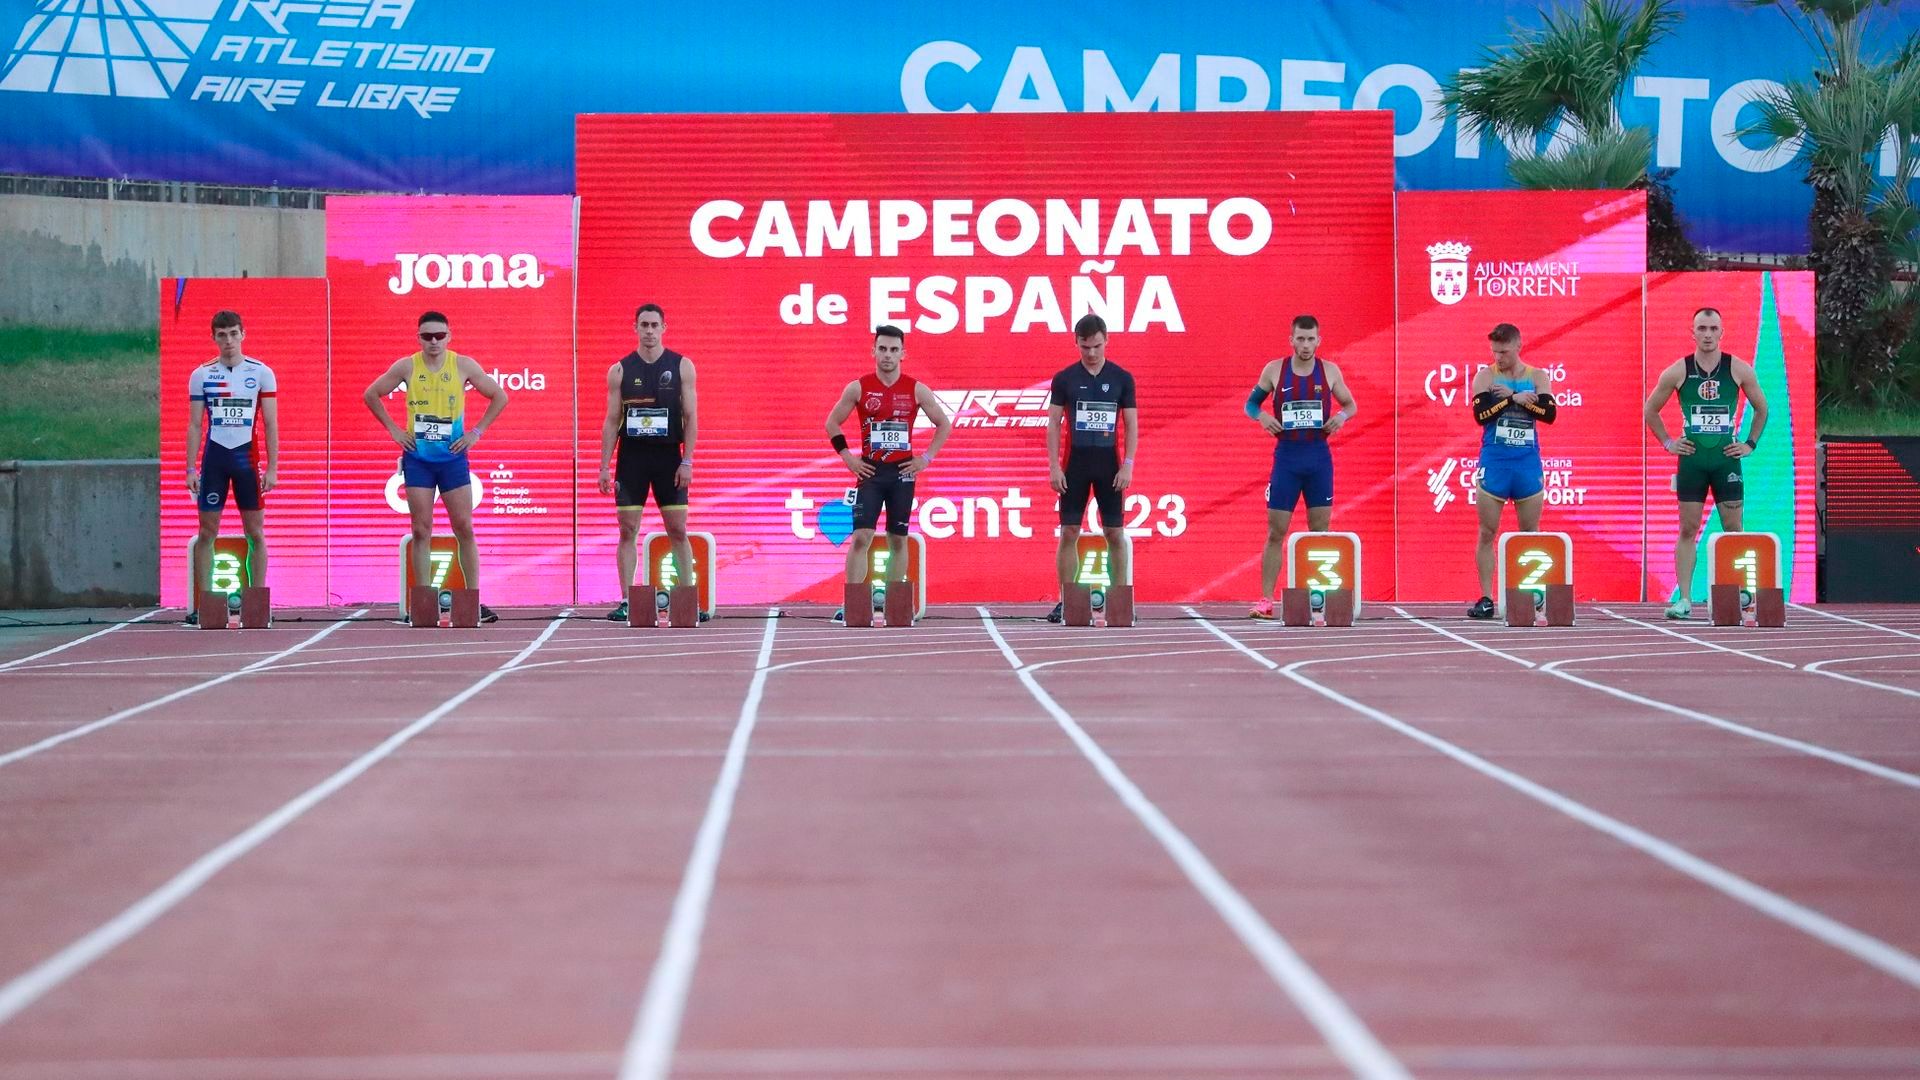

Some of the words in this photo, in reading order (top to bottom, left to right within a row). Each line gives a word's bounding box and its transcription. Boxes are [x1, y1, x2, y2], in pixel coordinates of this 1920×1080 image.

[210, 36, 496, 74] ATLETISMO
[191, 76, 306, 111] AIRE
[316, 81, 461, 119] LIBRE
[689, 197, 1273, 259] CAMPEONATO
[1474, 261, 1579, 279] AJUNTAMENT
[1474, 277, 1581, 297] TORRENT
[779, 283, 848, 325] de
[870, 260, 1186, 333] ESPAÑA
[961, 389, 1052, 416] RFE
[223, 408, 244, 418] 103
[955, 416, 1065, 428] ATLETISM
[1087, 412, 1108, 422] 398
[1293, 411, 1313, 420] 158
[1701, 415, 1721, 425] 125
[425, 423, 439, 433] 29
[881, 431, 900, 442] 188
[1507, 428, 1526, 439] 109
[492, 486, 530, 498] Consejo
[846, 490, 856, 504] 5
[493, 496, 532, 507] Superior
[492, 506, 505, 514] de
[506, 506, 548, 516] Deportes
[1054, 493, 1188, 538] 23
[430, 551, 454, 588] 7
[1078, 551, 1111, 594] 4
[1306, 550, 1343, 591] 3
[1518, 550, 1553, 590] 2
[1734, 550, 1757, 593] 1
